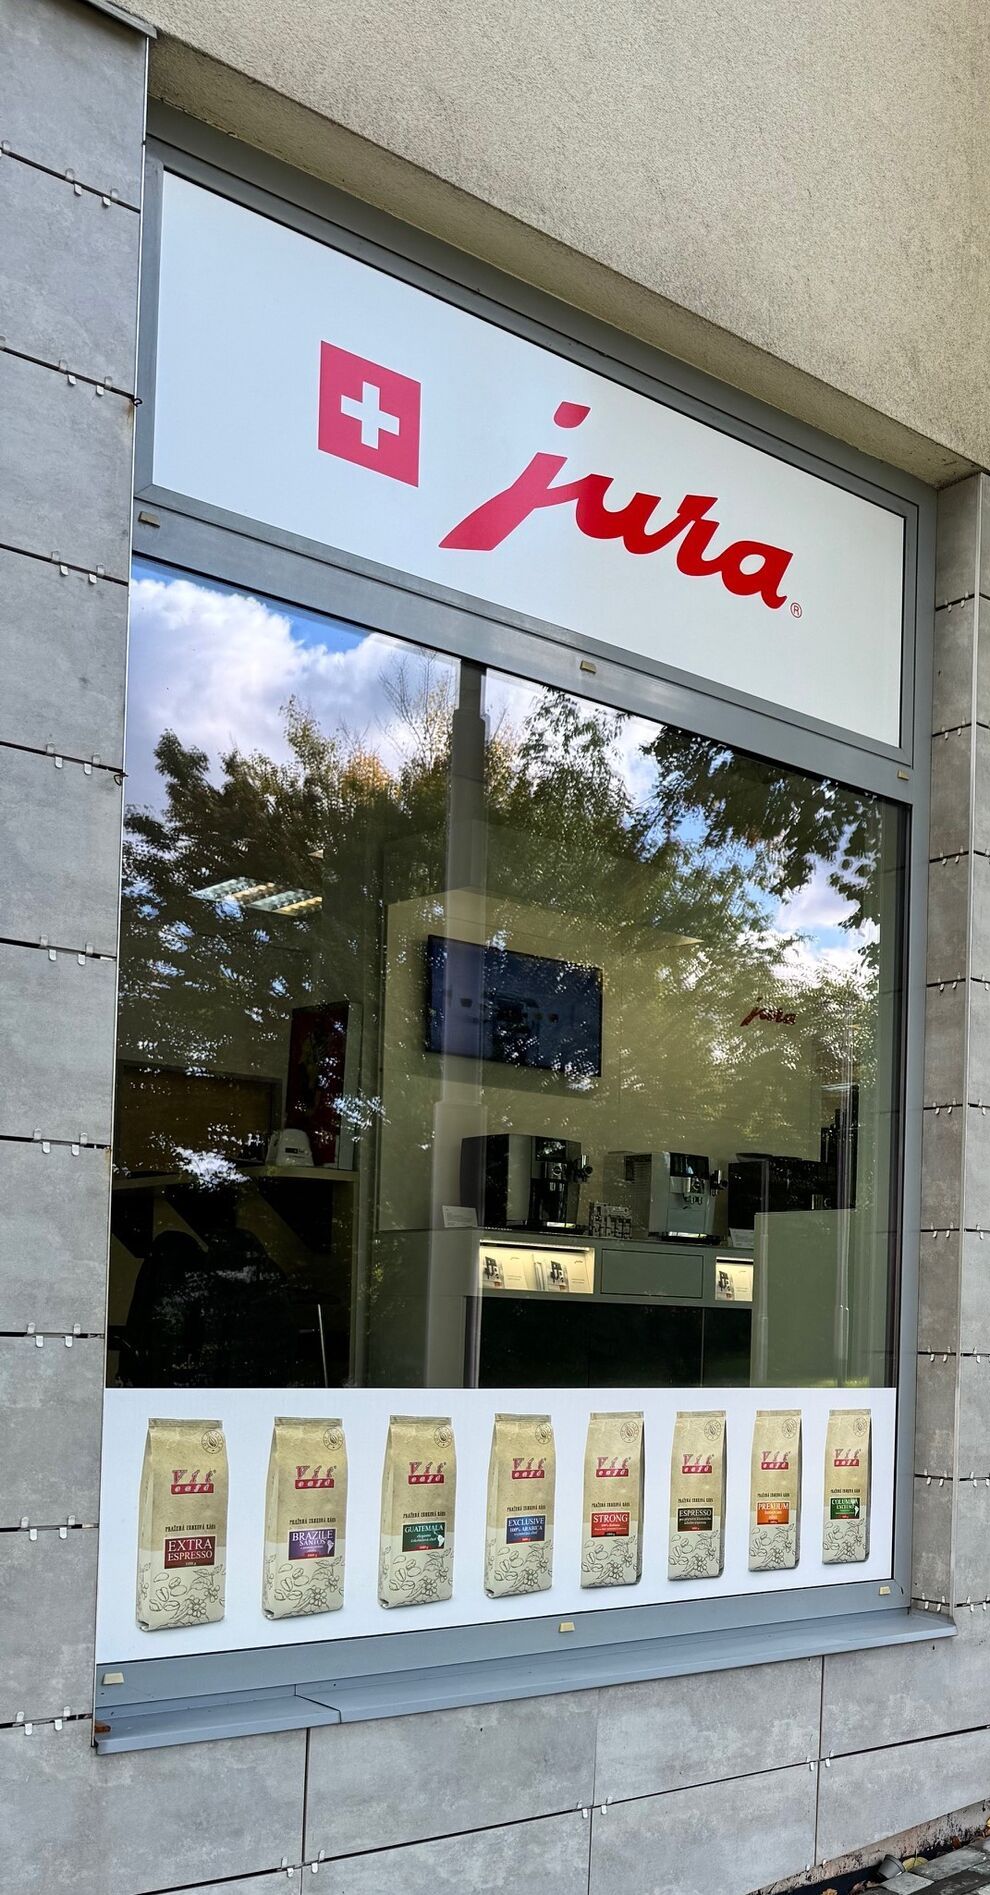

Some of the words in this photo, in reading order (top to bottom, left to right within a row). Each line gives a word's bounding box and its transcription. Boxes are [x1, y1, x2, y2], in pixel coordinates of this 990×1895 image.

[439, 401, 794, 610] jura
[758, 1502, 789, 1511] PREMIUM
[679, 1509, 712, 1517] ESPRESSO
[508, 1518, 545, 1527] EXCLUSIVE
[593, 1513, 628, 1523] STRONG
[405, 1525, 444, 1534] GUATEMALA
[292, 1530, 334, 1542] BRAZILE
[168, 1538, 213, 1552] EXTRA
[300, 1538, 326, 1547] SANTOS
[168, 1550, 213, 1562] ESPRESSO
